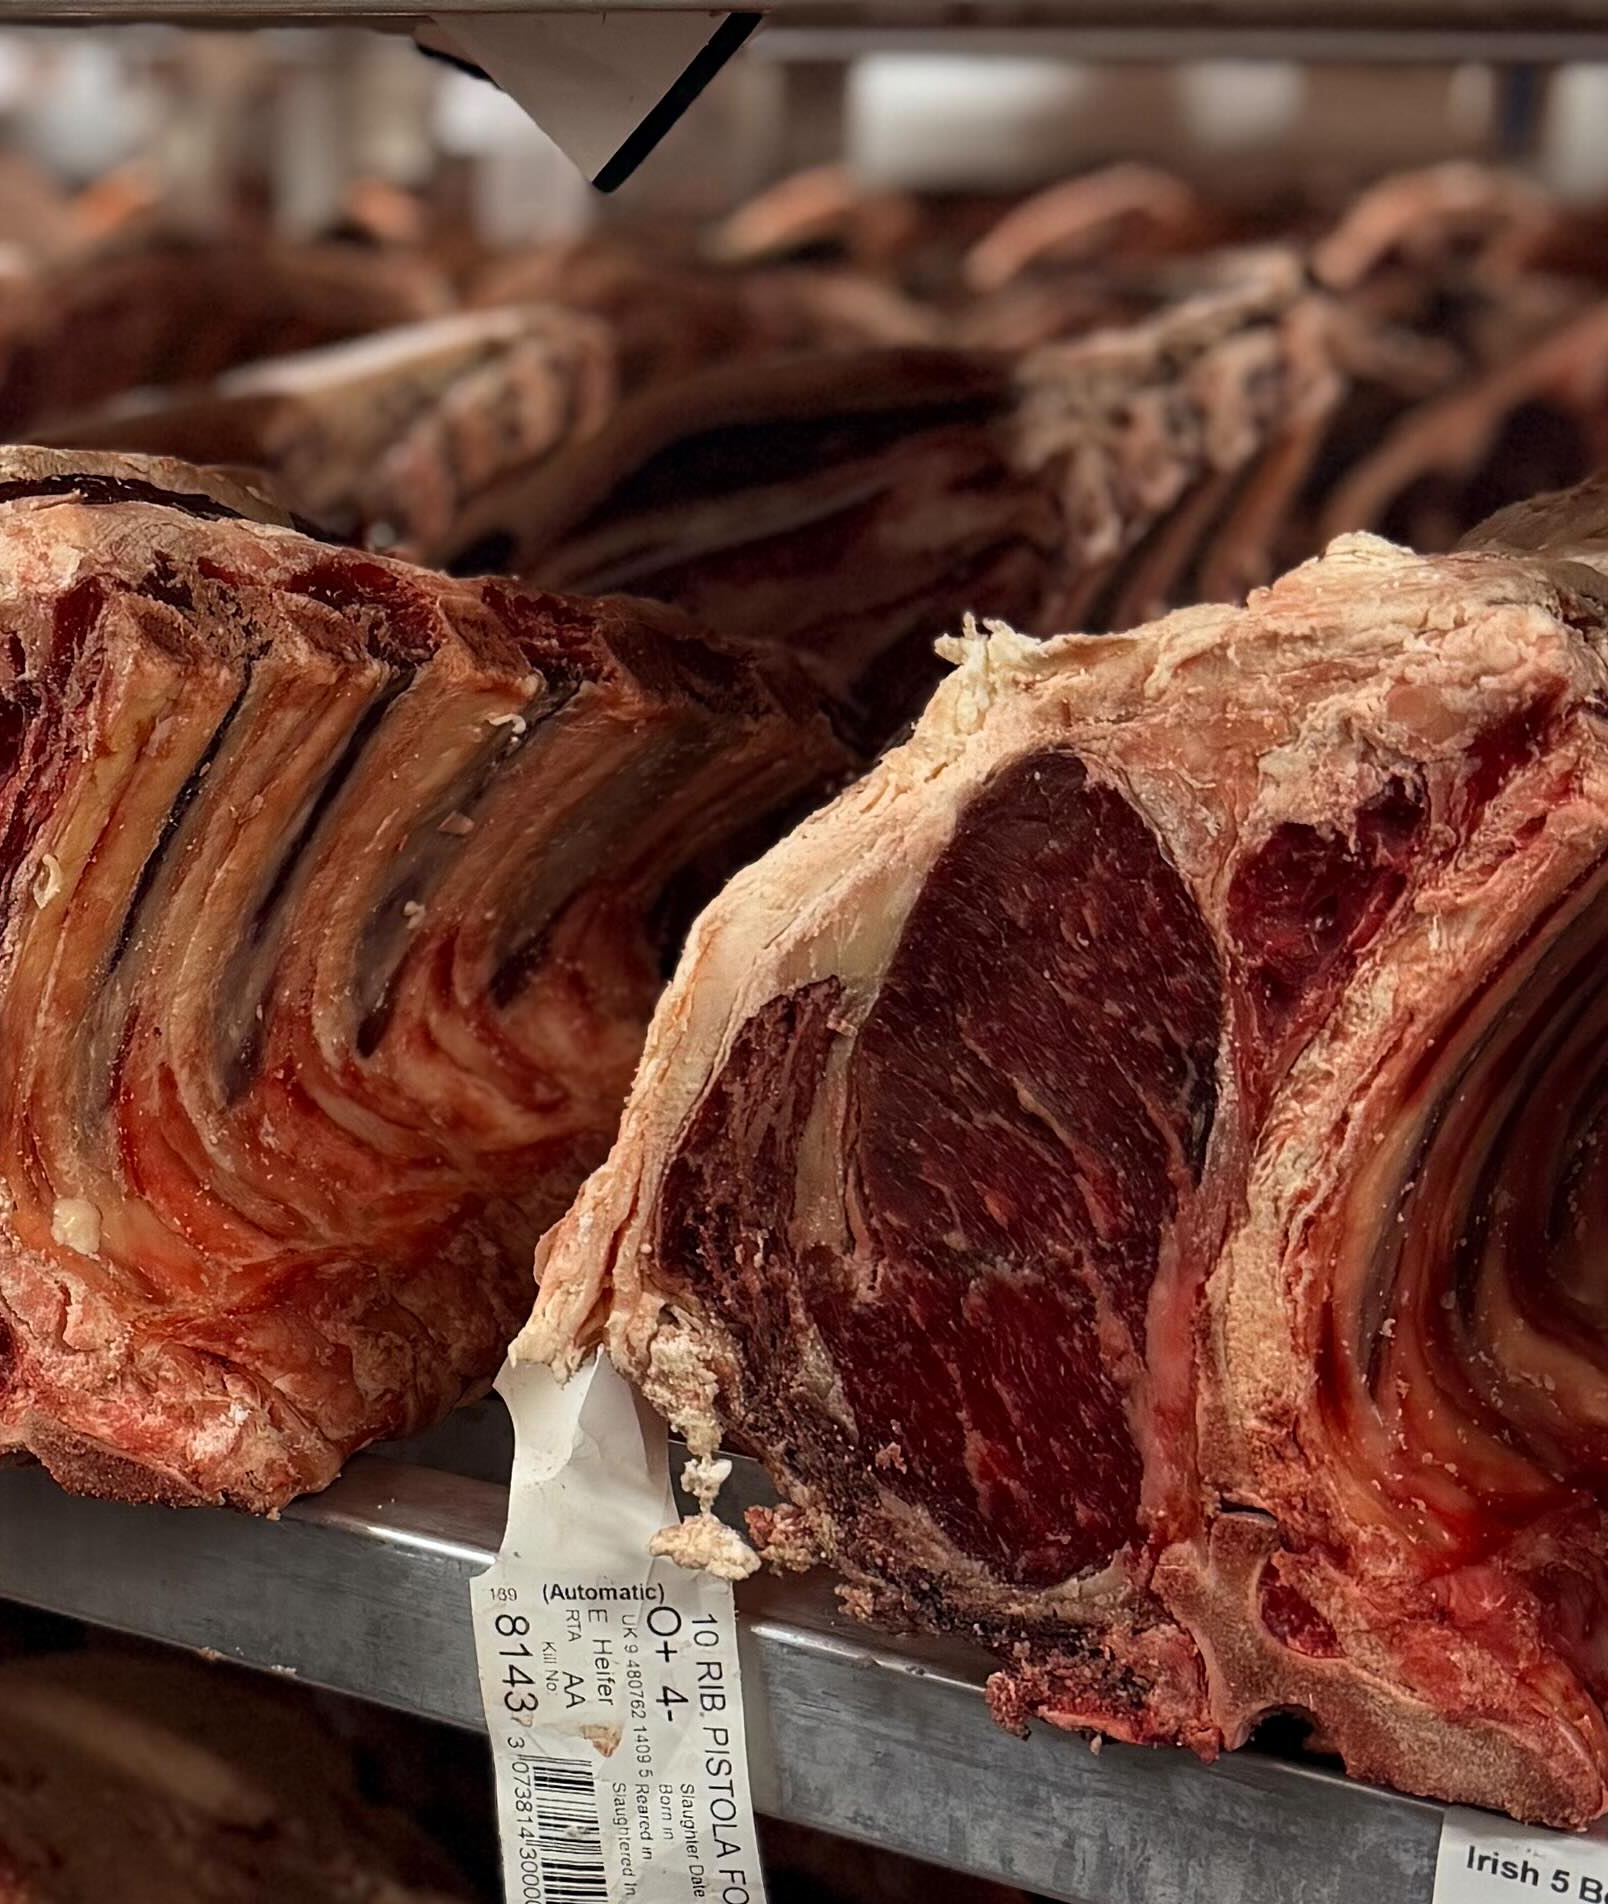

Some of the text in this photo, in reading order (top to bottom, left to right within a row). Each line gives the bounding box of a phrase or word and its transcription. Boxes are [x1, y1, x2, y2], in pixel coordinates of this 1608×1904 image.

[542, 1583, 665, 1605] (Automatic)
[622, 1615, 636, 1638] UK
[692, 1614, 719, 1646] 10
[495, 1615, 538, 1712] 8143
[543, 1642, 556, 1663] Kill
[562, 1610, 585, 1708] RTA AA
[588, 1609, 615, 1705] E Heifer
[624, 1645, 638, 1653] 9
[627, 1660, 646, 1718] 480762
[656, 1686, 688, 1721] 4-
[508, 1737, 525, 1748] 3
[634, 1726, 651, 1763] 1409
[512, 1760, 535, 1838] 073814
[659, 1784, 673, 1820] Born
[703, 1727, 741, 1858] PISTOLA
[635, 1784, 653, 1840] Reared
[680, 1784, 699, 1859] Slaughter
[612, 1783, 638, 1881] Slaughtered
[642, 1847, 652, 1859] in
[1466, 1845, 1540, 1887] Irish
[1551, 1869, 1570, 1893] 5
[689, 1865, 706, 1897] Date
